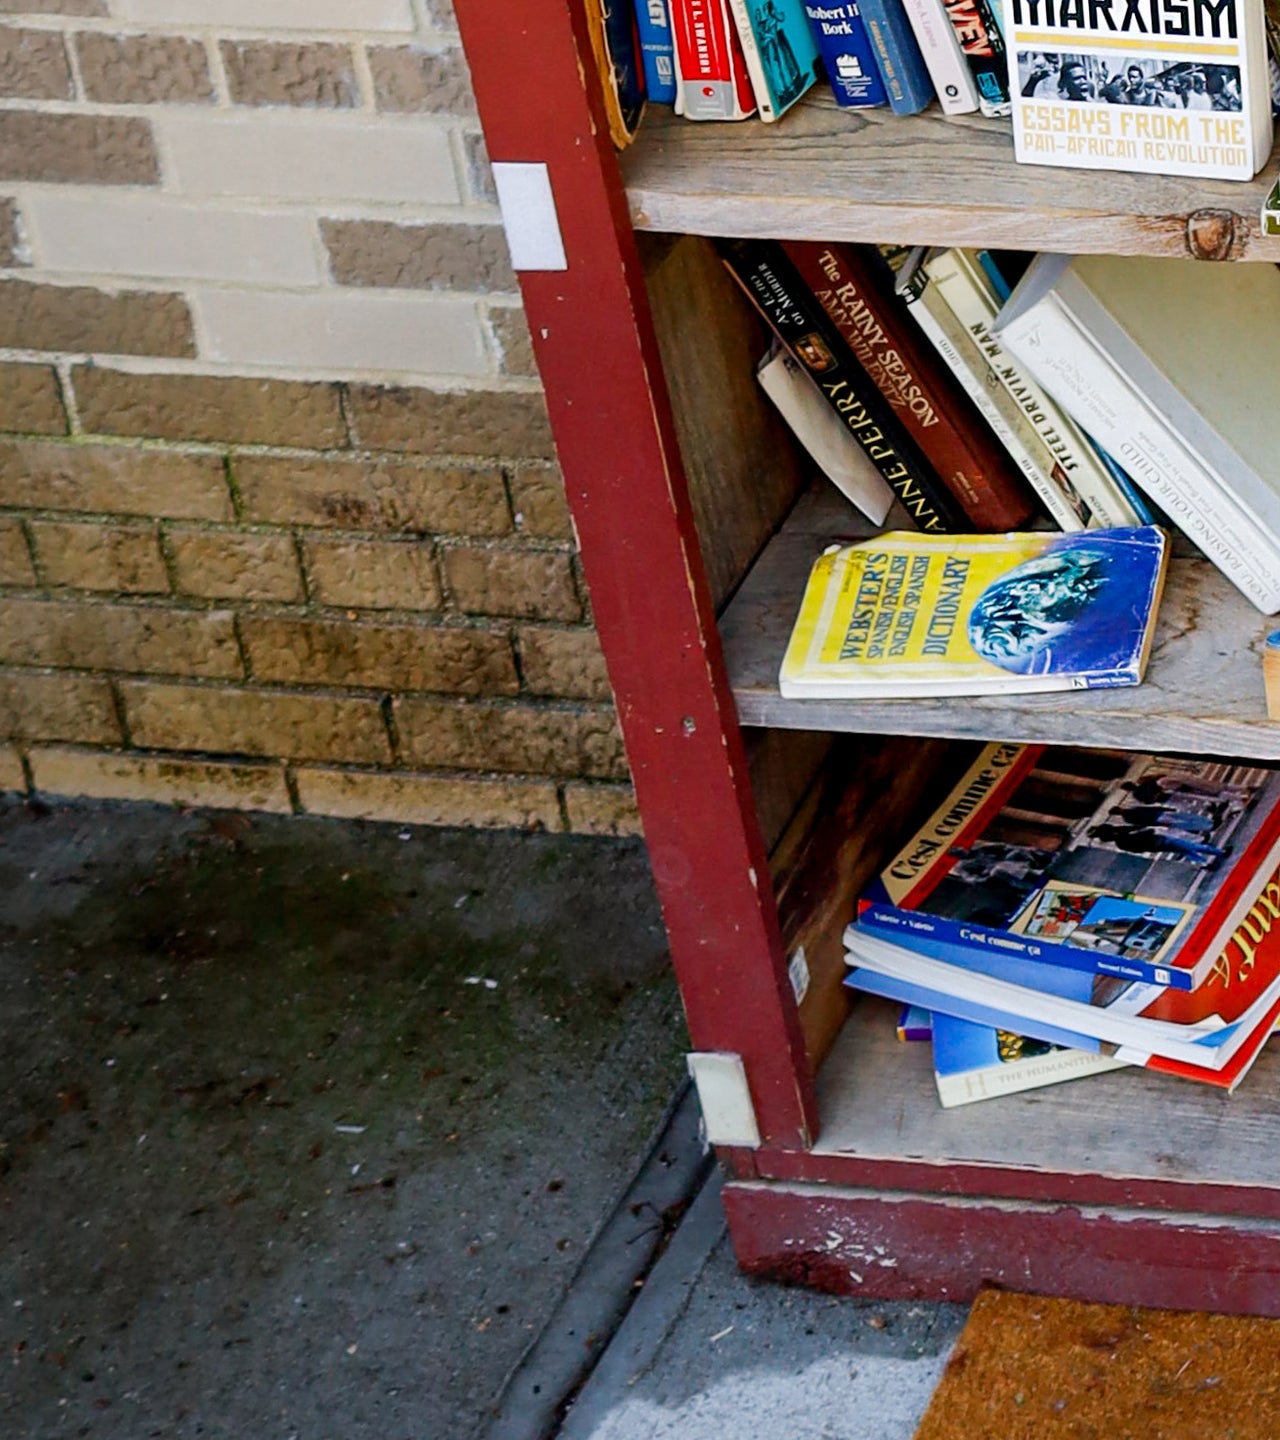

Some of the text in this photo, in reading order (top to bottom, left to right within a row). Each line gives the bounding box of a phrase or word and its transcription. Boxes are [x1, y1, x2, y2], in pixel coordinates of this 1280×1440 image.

[805, 3, 845, 21] Robert
[821, 20, 854, 37] Bork
[691, 21, 713, 74] SWANSON
[1021, 105, 1247, 145] ESSAYS FROM THE
[1023, 133, 1248, 167] PAN-AFRICAN REVOLUTION
[814, 248, 944, 431] The RAINY SEASON
[841, 328, 910, 413] WILENTZ
[968, 319, 1079, 474] STEEL DRIVIN' MAN
[821, 371, 949, 540] ANNE PERRY
[1117, 438, 1165, 490] CHILD
[1156, 479, 1197, 522] YOUR
[1190, 515, 1244, 573] RAISING
[839, 552, 889, 662] WEBSTER'S
[867, 554, 909, 661] SPANISH/ENGLISH
[888, 555, 931, 658] ENGLISH/SPANISH
[923, 556, 973, 658] DICTIONARY
[933, 773, 1000, 851] comme
[986, 934, 1026, 952] comme
